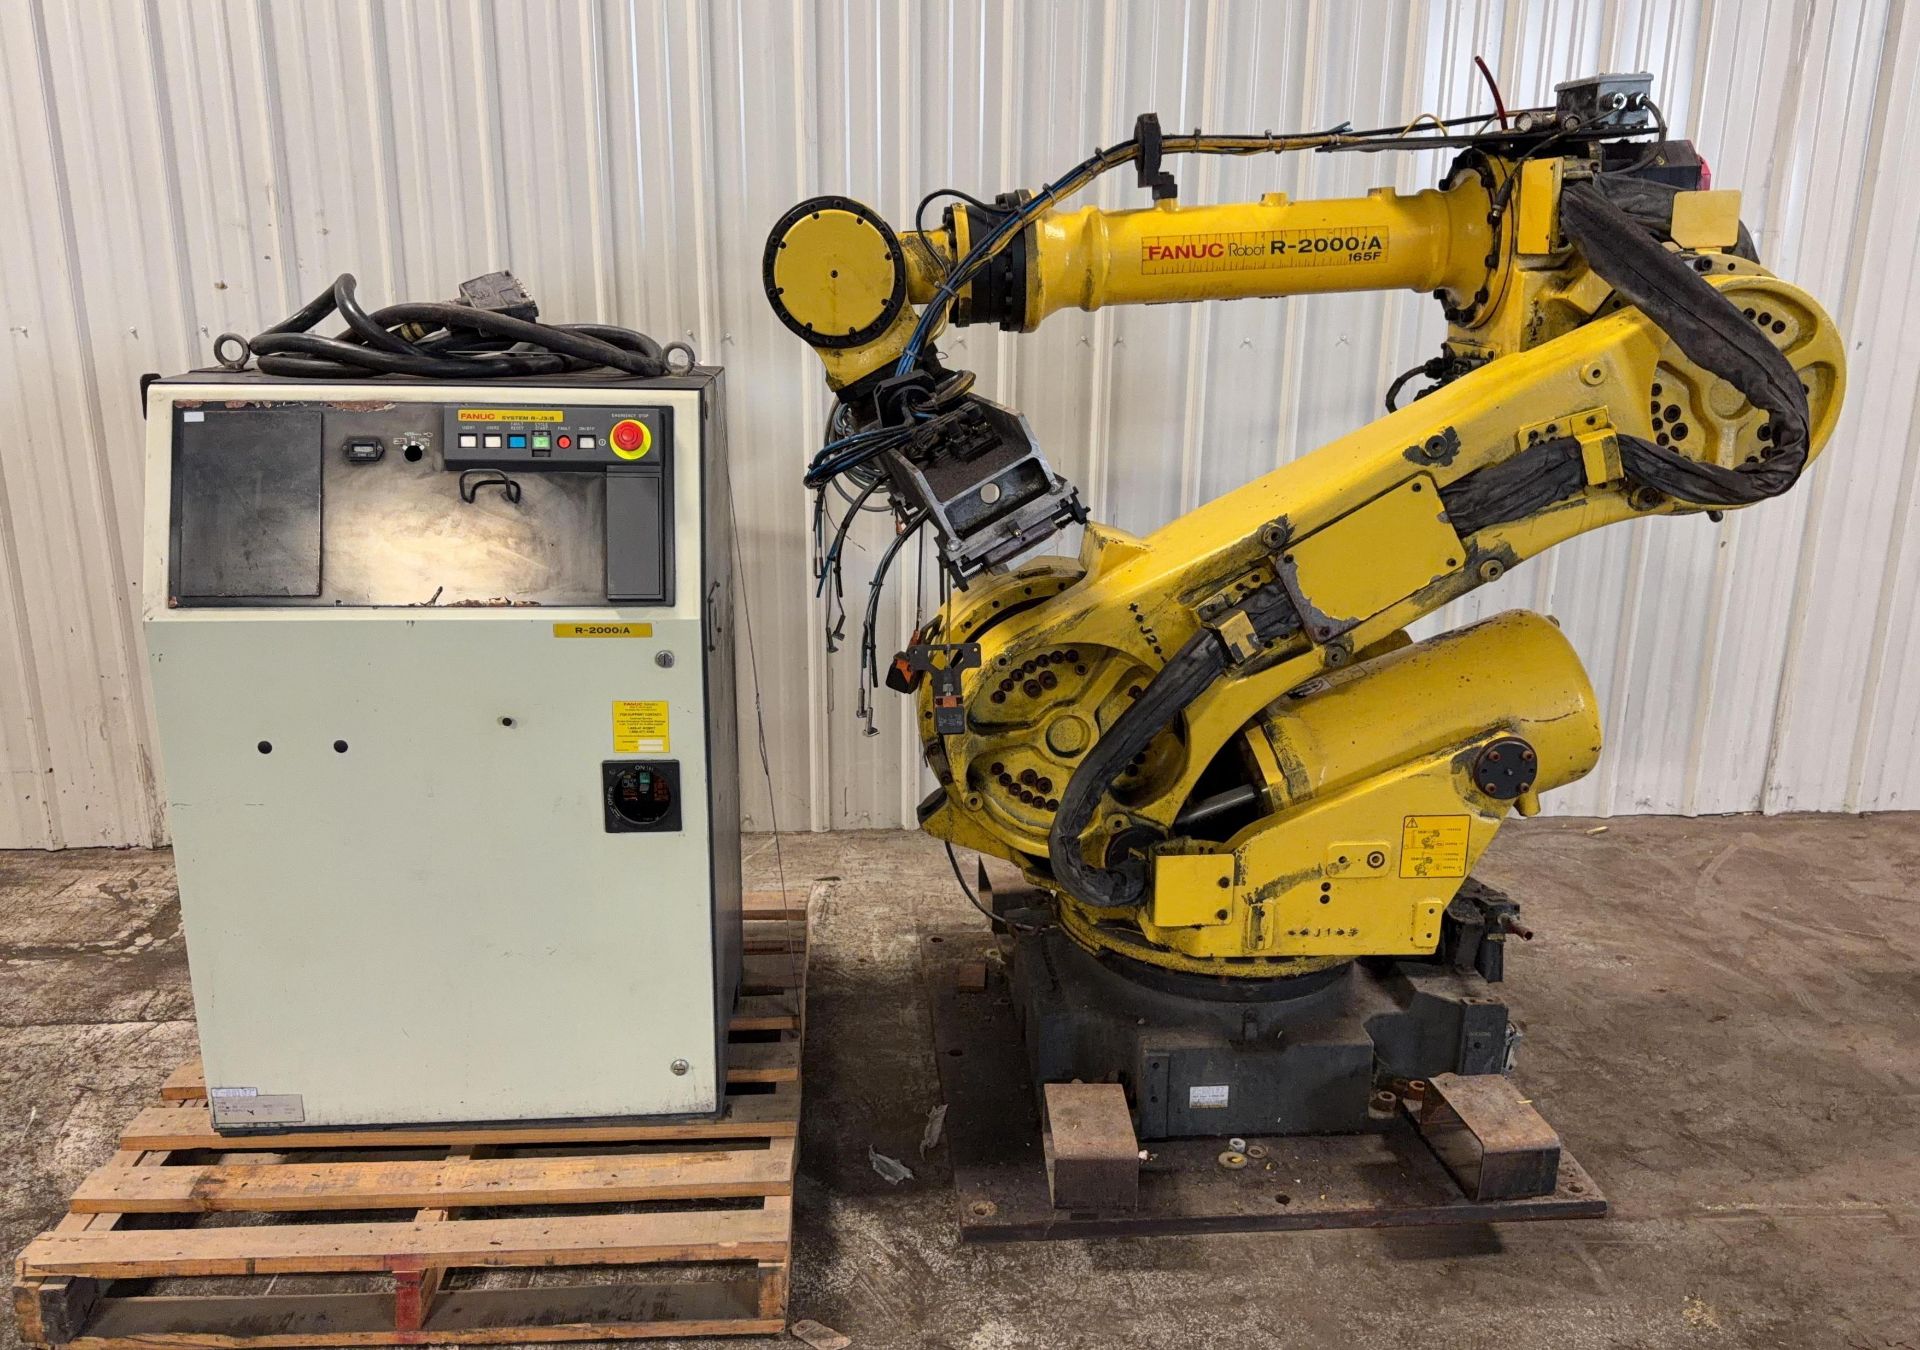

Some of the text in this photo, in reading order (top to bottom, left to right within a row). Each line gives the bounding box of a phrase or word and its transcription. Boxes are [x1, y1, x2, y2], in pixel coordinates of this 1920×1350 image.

[1149, 236, 1382, 260] FANUC Robot R-2000iA
[1348, 251, 1382, 262] 165F
[460, 412, 496, 420] FANUC
